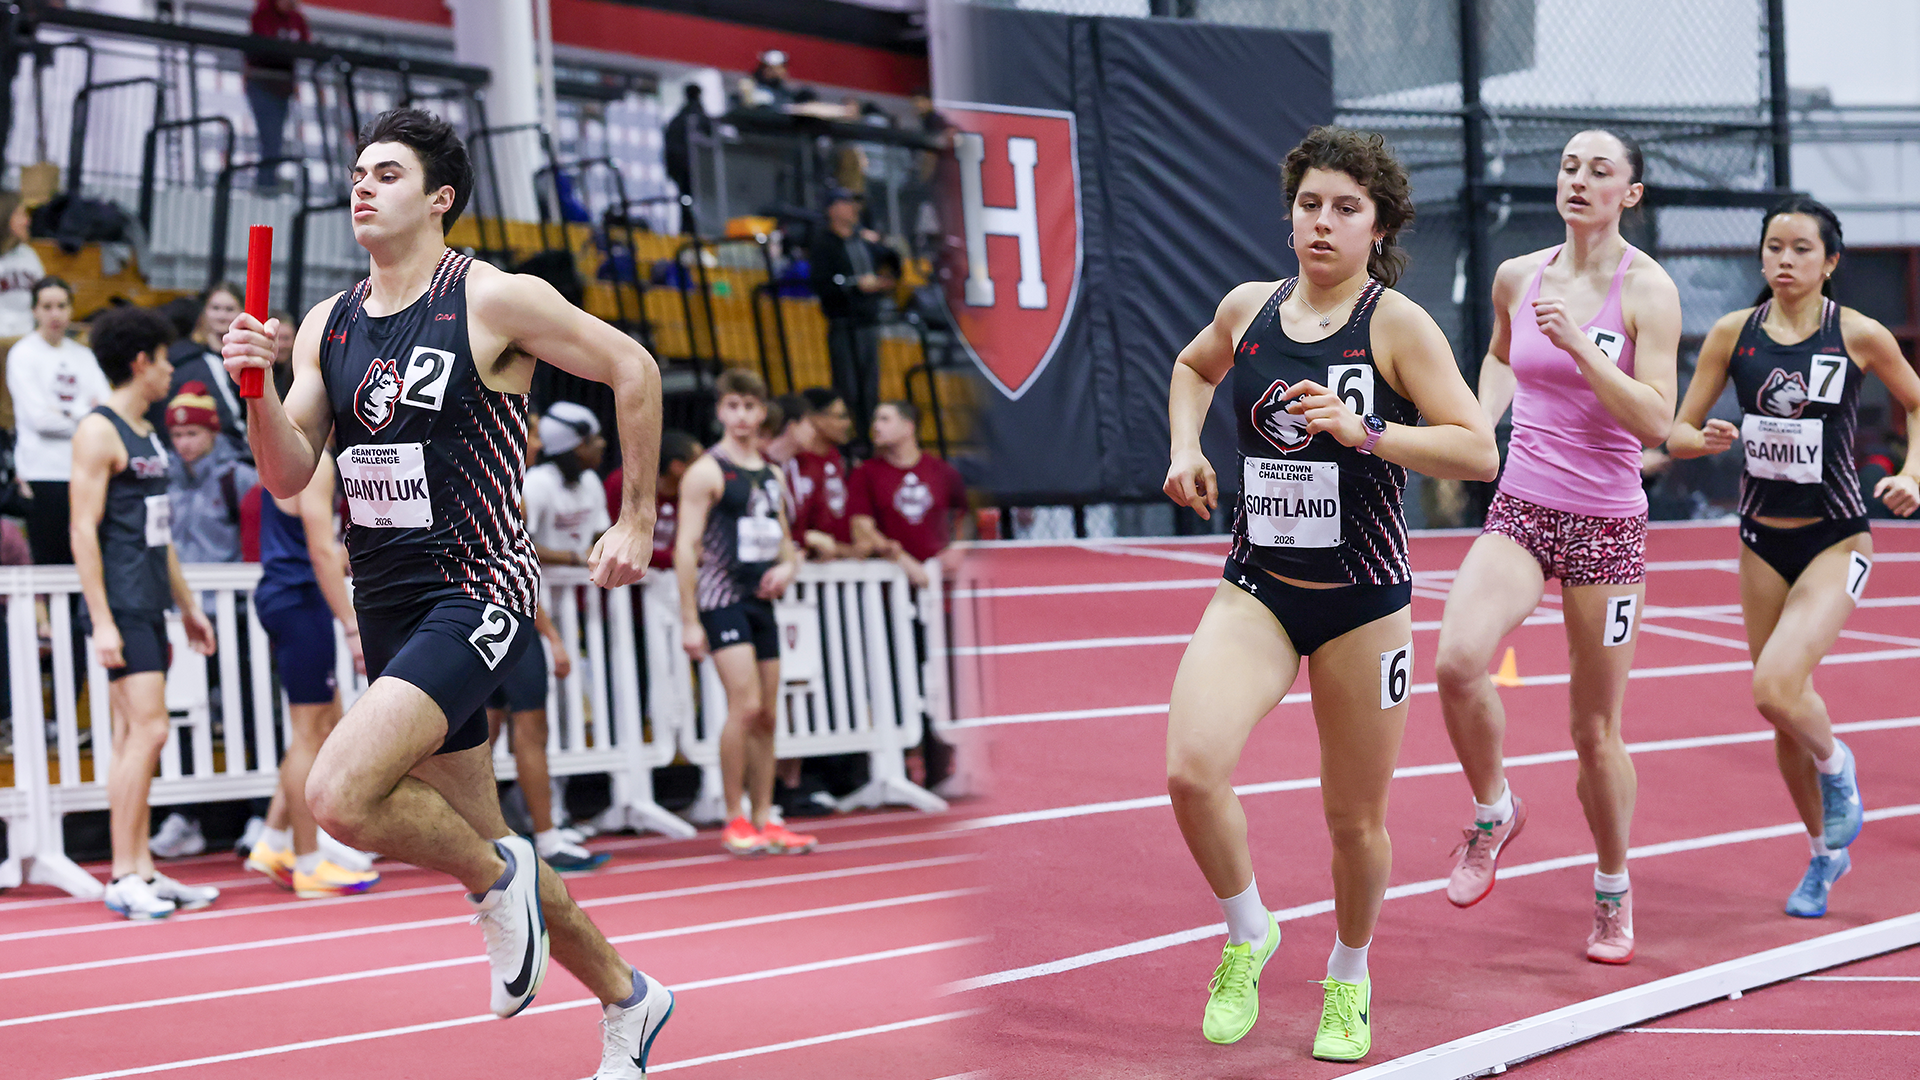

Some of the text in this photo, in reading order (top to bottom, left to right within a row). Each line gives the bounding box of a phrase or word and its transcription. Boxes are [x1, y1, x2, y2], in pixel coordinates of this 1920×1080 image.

[953, 132, 1048, 309] H
[434, 313, 456, 321] CAA
[1342, 349, 1366, 358] CAA
[406, 352, 445, 406] 2
[1817, 360, 1841, 398] 7
[1337, 368, 1365, 416] 6
[351, 448, 398, 456] BEANTOWN
[351, 456, 400, 464] CHALLENGE
[1746, 440, 1818, 464] GAMILY
[1258, 471, 1314, 481] CHALLENGE
[1260, 462, 1312, 473] BEANTOWN
[344, 477, 428, 501] DANYLUK
[1246, 494, 1337, 518] SORTLAND
[374, 517, 393, 526] 2026
[1273, 535, 1295, 545] 2026
[1852, 557, 1868, 594] 7
[1613, 599, 1631, 643] 5
[474, 609, 511, 664] 2
[1389, 650, 1407, 703] 6
